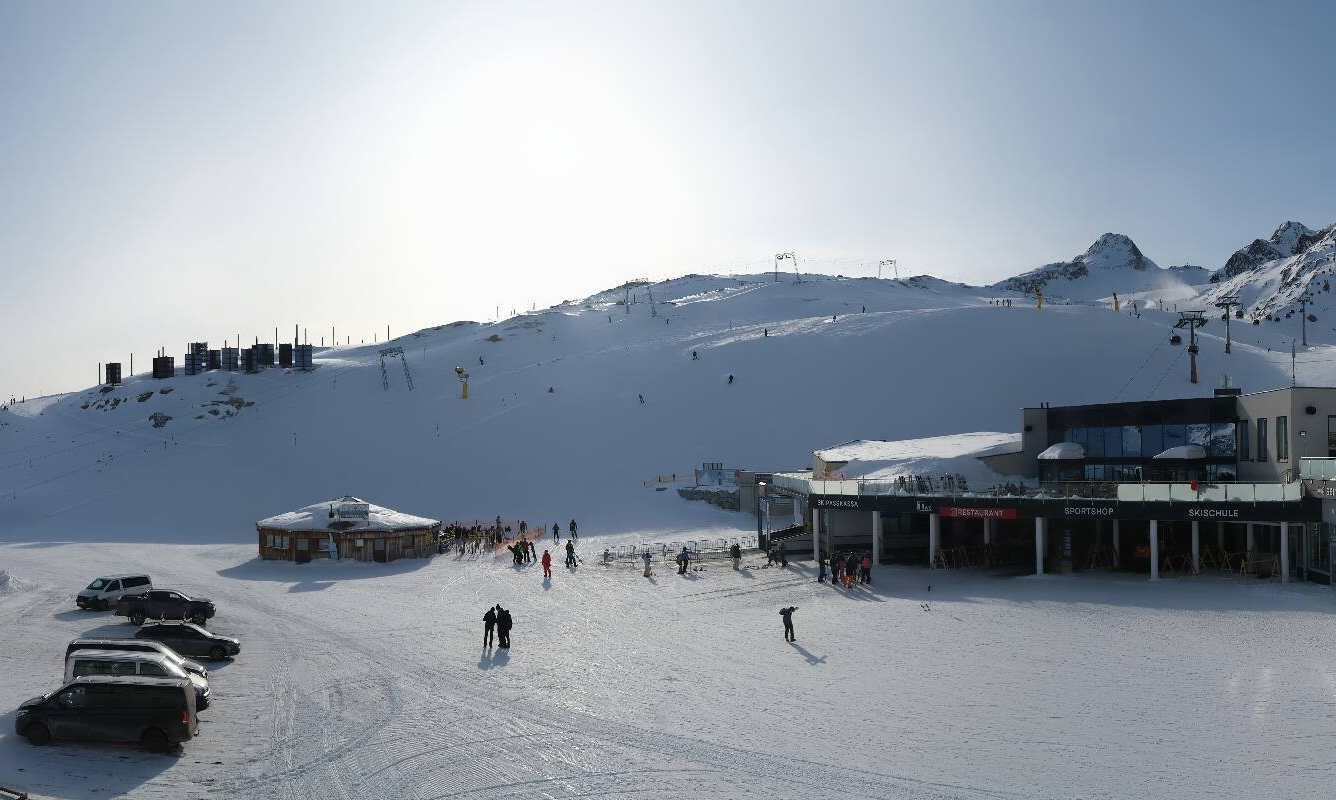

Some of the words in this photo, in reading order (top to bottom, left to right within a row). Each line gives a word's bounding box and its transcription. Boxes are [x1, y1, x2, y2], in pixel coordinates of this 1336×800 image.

[817, 499, 859, 508] SKPASSKASSA
[957, 508, 1004, 518] RESTAURANT
[1064, 507, 1114, 516] SPORTSHOP
[1188, 509, 1239, 517] SKISCHULE
